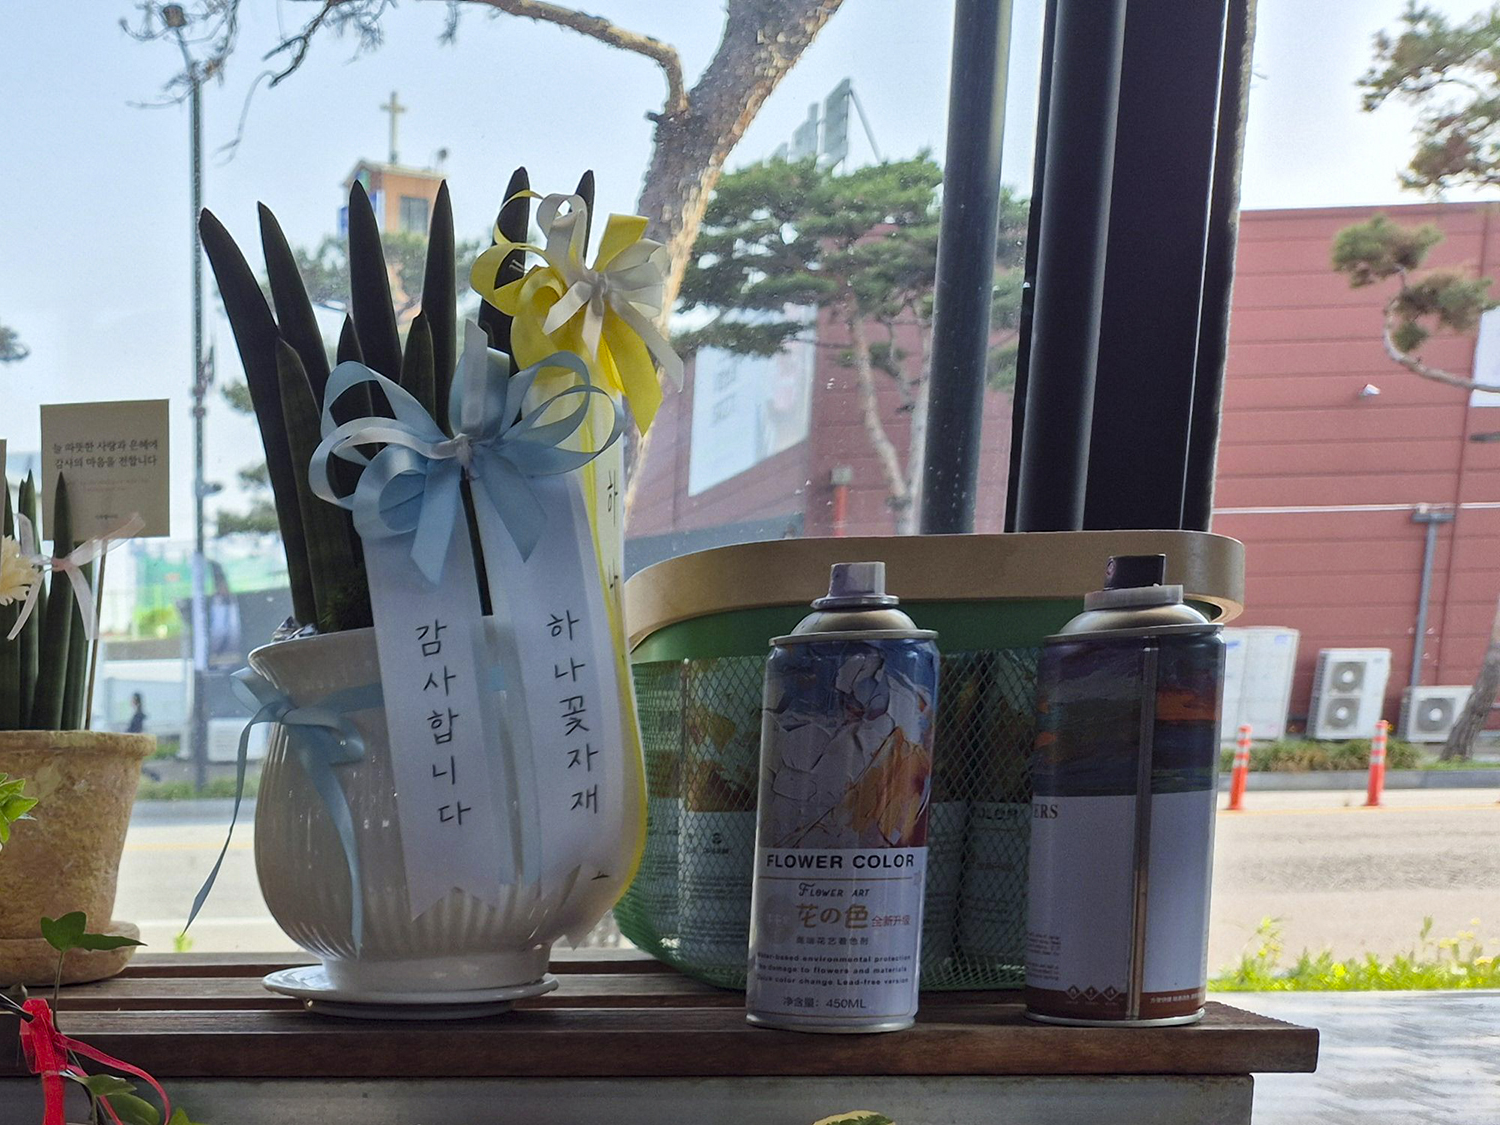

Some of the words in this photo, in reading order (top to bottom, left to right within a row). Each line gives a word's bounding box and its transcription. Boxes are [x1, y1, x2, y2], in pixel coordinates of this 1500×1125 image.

[54, 442, 63, 454] 늘
[66, 442, 94, 452] 따뜻한
[97, 441, 126, 452] 사랑과
[130, 439, 158, 450] 은혜에
[56, 458, 83, 469] 감사의
[86, 457, 115, 468] 마음을
[118, 456, 157, 468] 전합니다
[546, 609, 599, 814] 하나꽃자재
[415, 619, 472, 825] 감사합니다
[766, 854, 843, 869] FLOWER
[852, 854, 914, 869] COLOR
[826, 998, 867, 1009] 450ML
